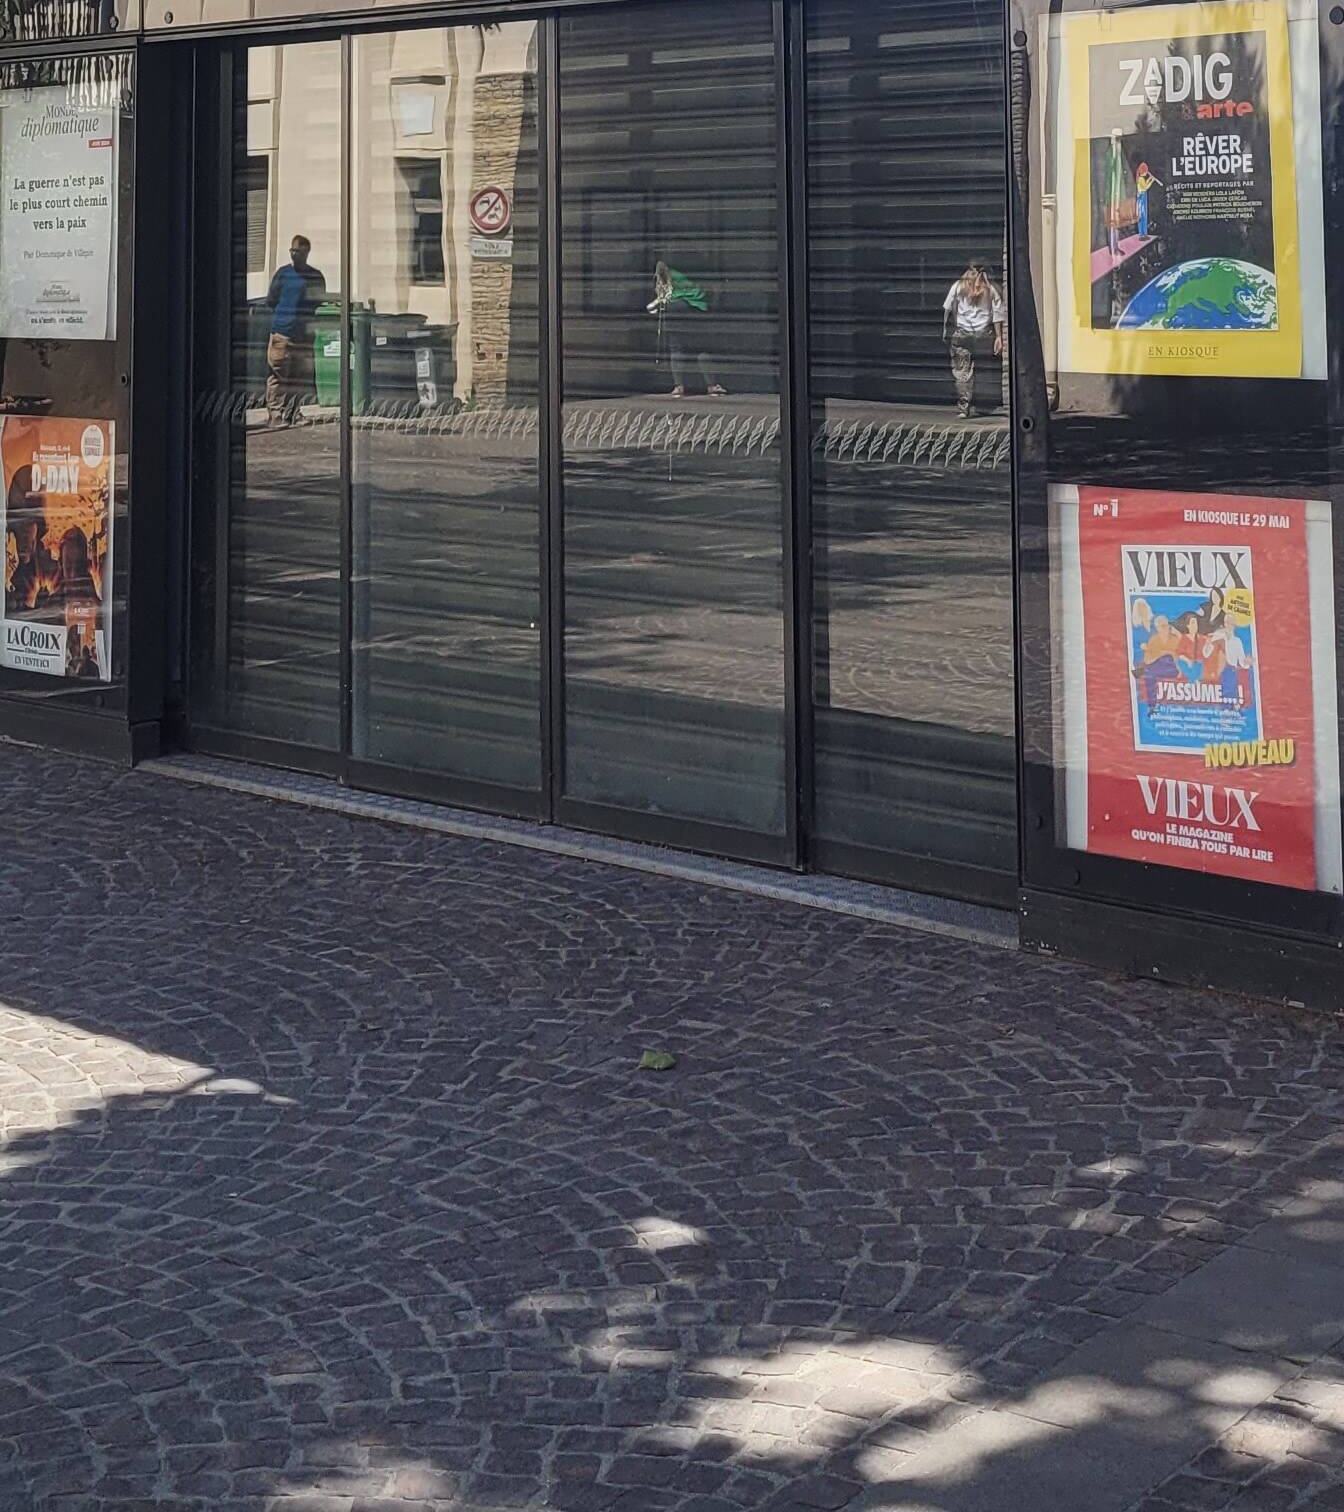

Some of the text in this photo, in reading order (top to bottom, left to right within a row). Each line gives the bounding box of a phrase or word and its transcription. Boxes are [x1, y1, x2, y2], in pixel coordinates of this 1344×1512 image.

[1119, 52, 1233, 105] ZADIG
[1197, 100, 1254, 119] arte
[21, 117, 99, 142] diplomatique
[1183, 132, 1241, 156] RÊVER
[1172, 153, 1254, 176] L'EUROPE
[14, 175, 105, 192] La guerre n'est pas
[10, 194, 108, 213] le plus court chemin
[33, 216, 87, 232] vers la paix
[1148, 346, 1219, 358] EN KIOSQUE
[1110, 498, 1119, 517] 1
[1183, 509, 1290, 529] EN KIOSQUE LE 29 MAI
[1126, 551, 1248, 589] VIEUX
[1205, 738, 1294, 767] NOUVEAU
[1136, 775, 1261, 831] VIEUX
[1166, 823, 1233, 843] LE MAGAZINE
[1131, 829, 1273, 863] QU'ON FINIRA TOUS PAR LIRE
